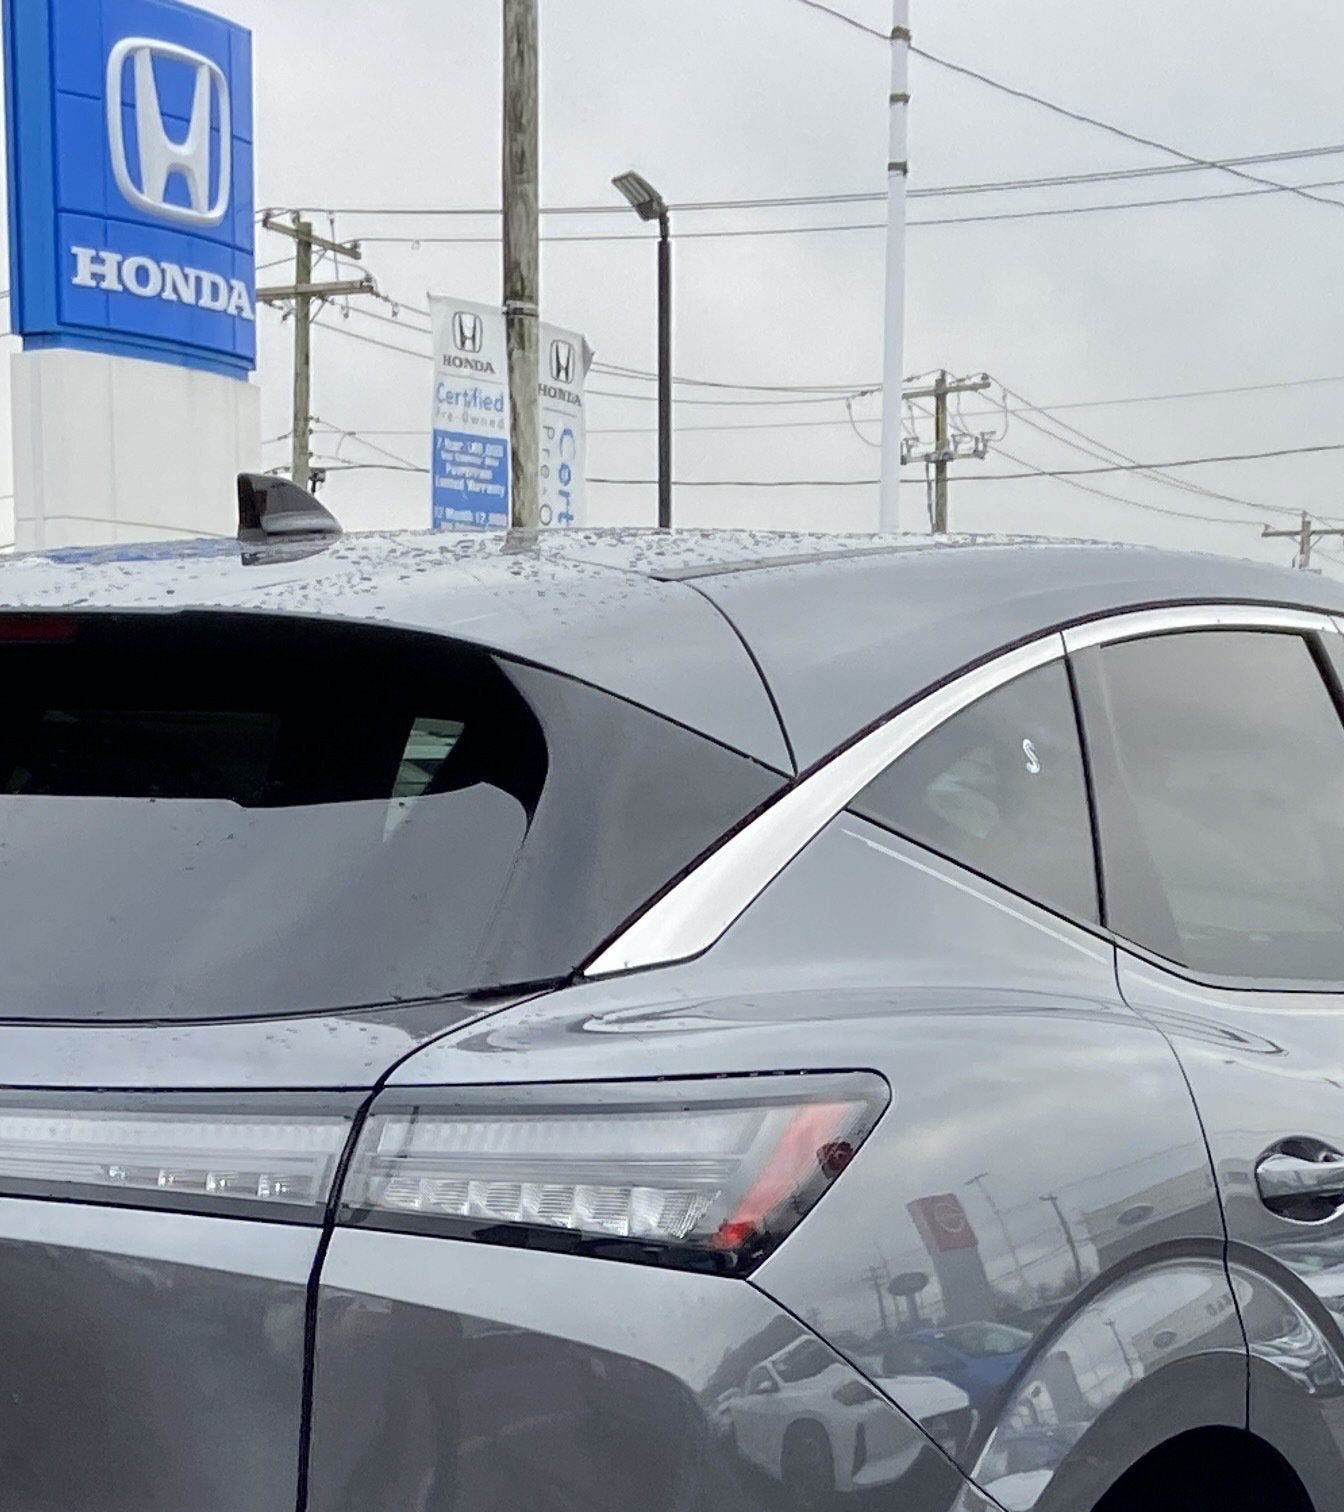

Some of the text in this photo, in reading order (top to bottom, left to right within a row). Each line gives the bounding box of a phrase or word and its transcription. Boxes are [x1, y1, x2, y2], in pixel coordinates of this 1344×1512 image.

[71, 246, 254, 320] HONDA
[442, 354, 496, 374] HONDA
[436, 382, 504, 413] Certified
